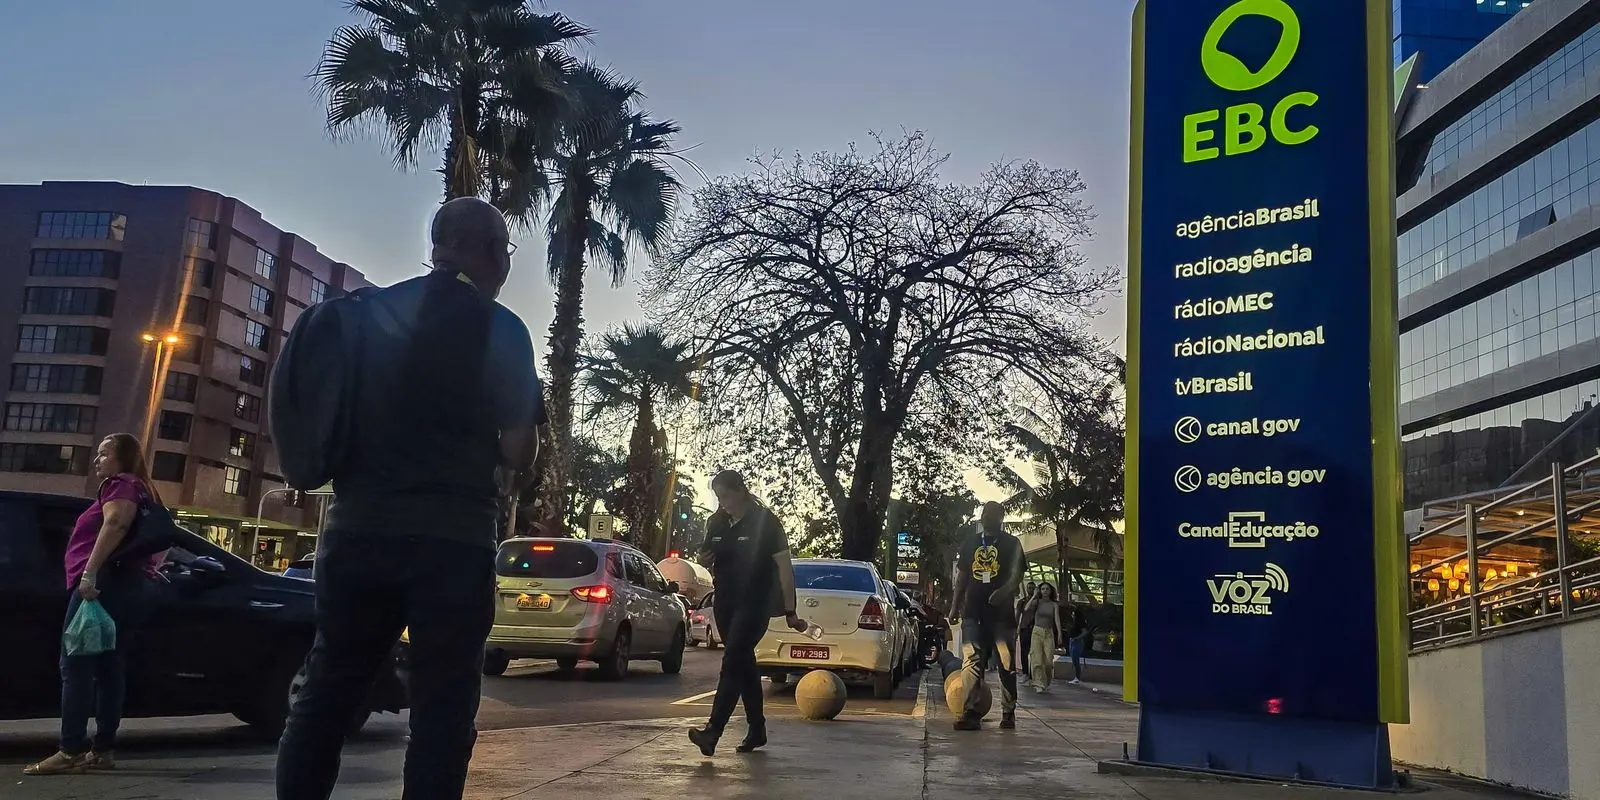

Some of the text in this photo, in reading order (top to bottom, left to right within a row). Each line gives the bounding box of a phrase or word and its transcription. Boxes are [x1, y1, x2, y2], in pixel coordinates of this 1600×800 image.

[1183, 92, 1319, 163] EBC
[1176, 199, 1319, 239] agênciaBrasil
[1176, 244, 1312, 278] radioagência
[1175, 292, 1273, 319] rádioMEC
[1175, 326, 1325, 357] rádioNacional
[1175, 371, 1253, 395] tvBrasil
[1207, 418, 1300, 437] canal gov
[1207, 466, 1326, 489] agência gov
[598, 521, 604, 530] E
[1179, 521, 1319, 542] CanalEducação
[1207, 579, 1271, 604] VOZ
[1213, 603, 1272, 615] DO BRASIL
